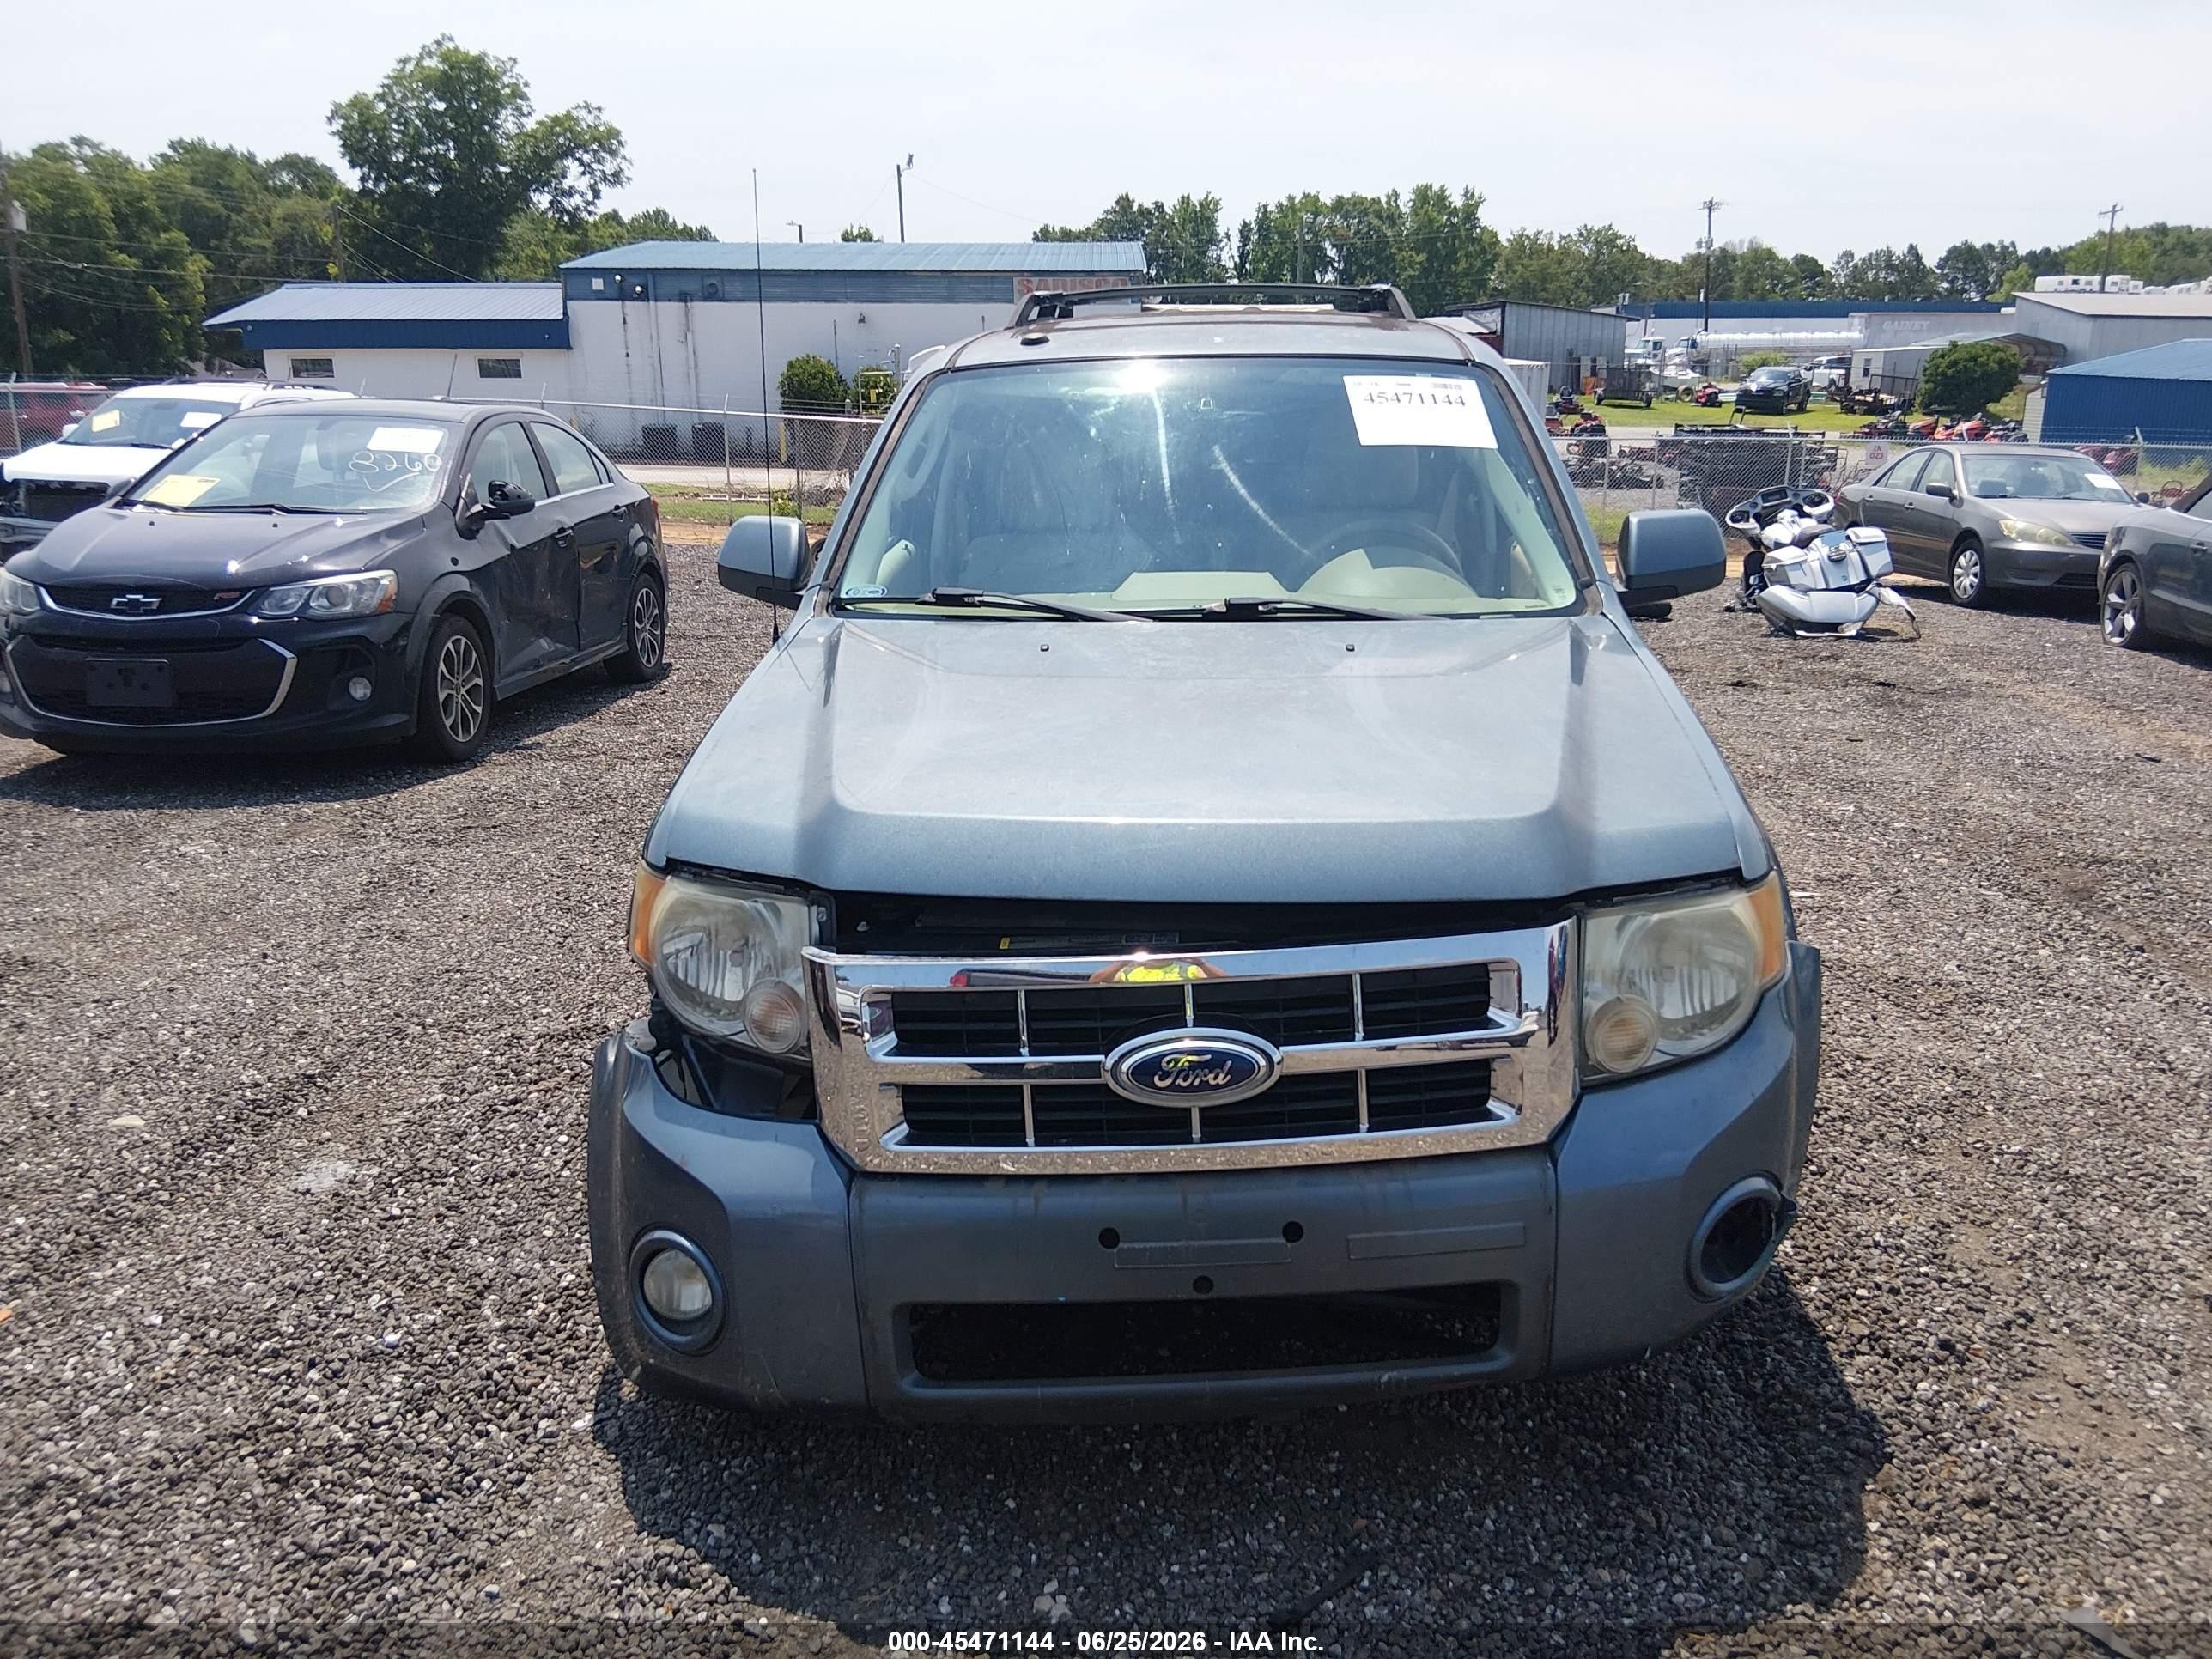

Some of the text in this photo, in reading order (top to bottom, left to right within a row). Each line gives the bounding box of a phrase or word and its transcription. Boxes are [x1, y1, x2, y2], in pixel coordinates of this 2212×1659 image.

[1364, 392, 1466, 407] 45471144
[349, 451, 442, 472] 8260
[1153, 1054, 1231, 1088] Ford
